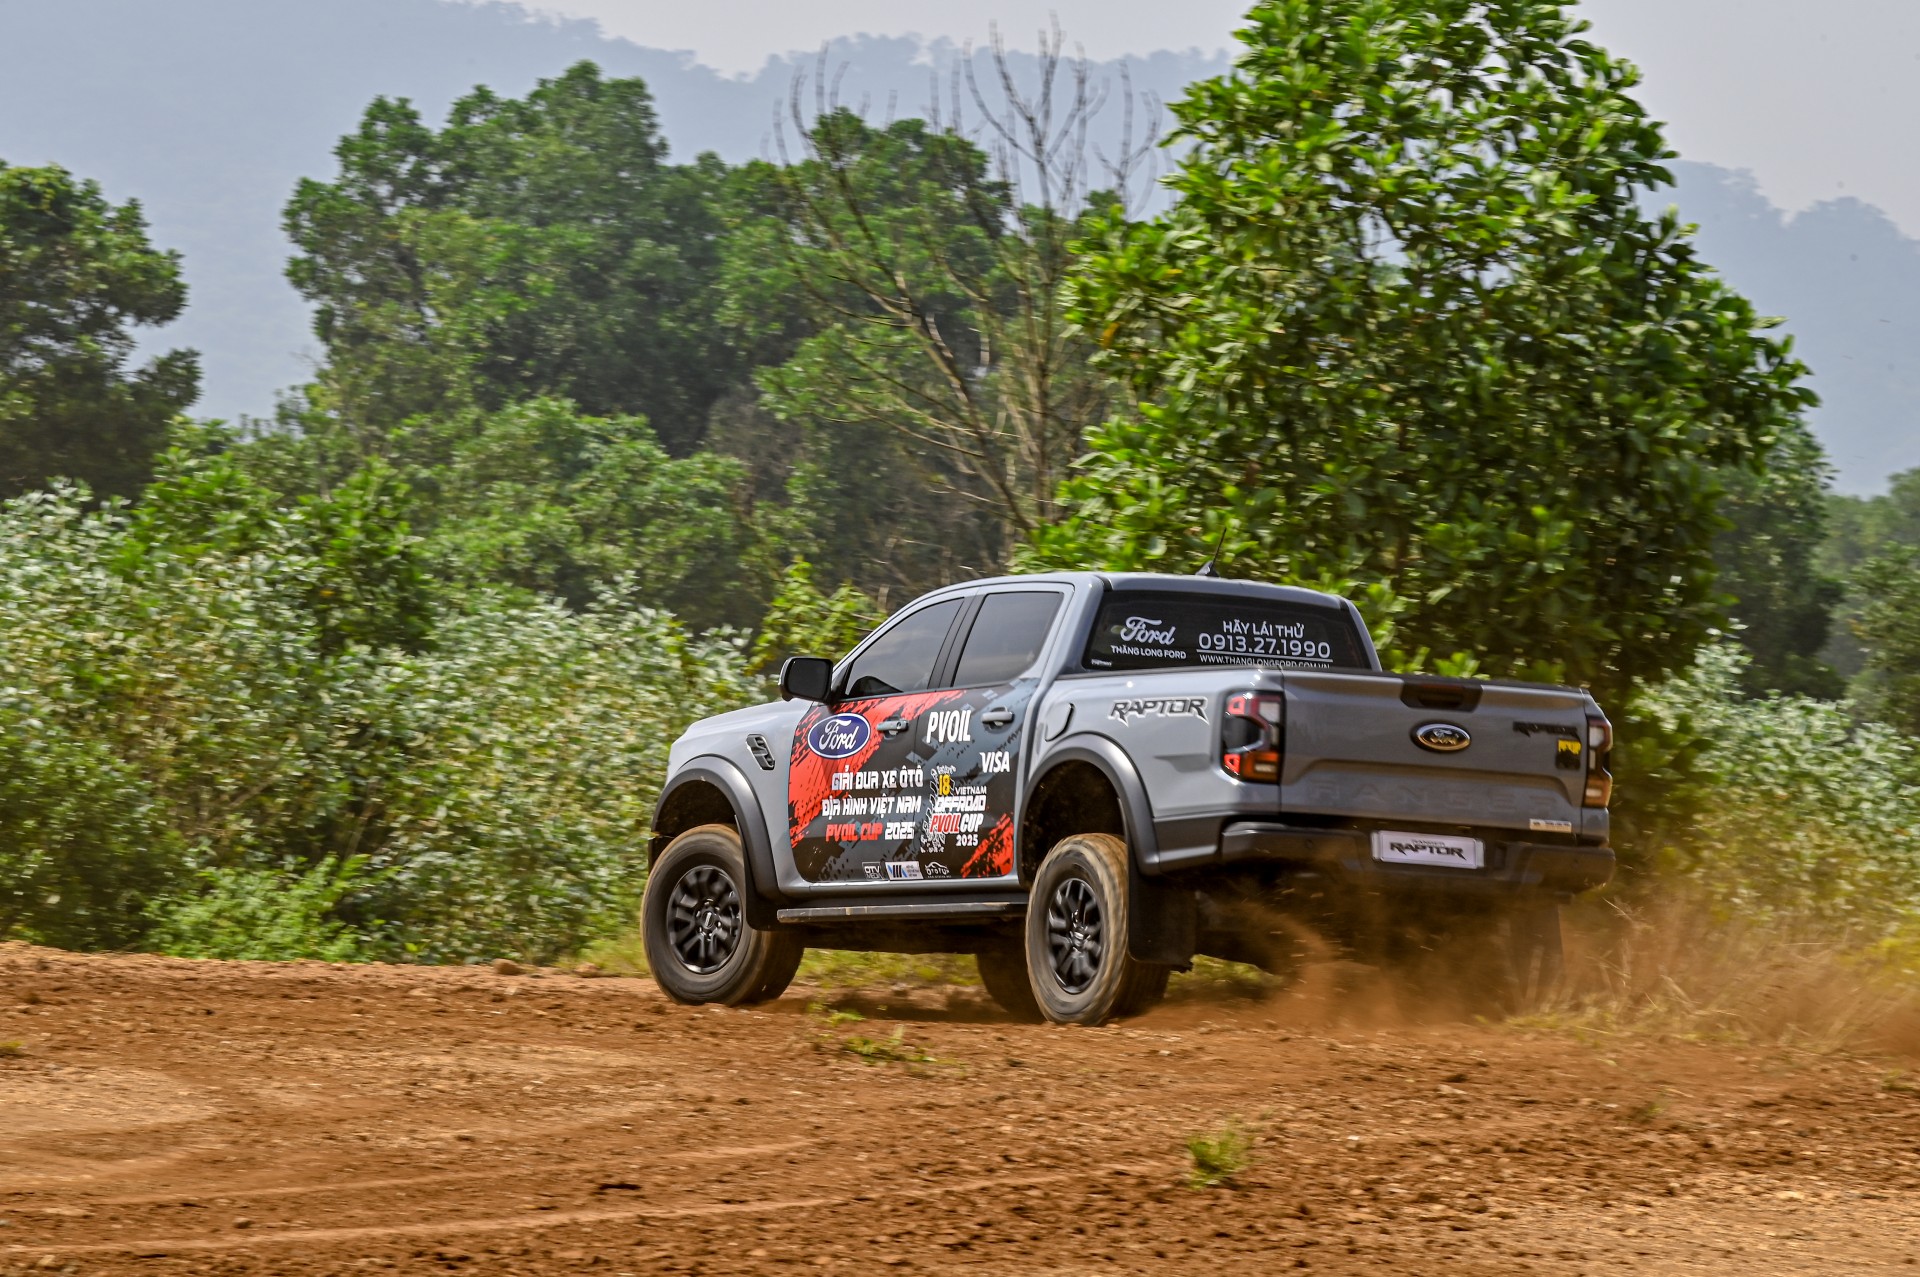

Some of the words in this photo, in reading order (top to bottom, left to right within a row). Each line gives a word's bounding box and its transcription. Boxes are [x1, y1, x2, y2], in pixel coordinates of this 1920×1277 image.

[1120, 616, 1176, 645] Ford
[1223, 619, 1250, 634] HÃY
[1252, 620, 1273, 636] LÁI
[1275, 622, 1304, 639] THỬ
[1110, 644, 1139, 656] THĂNG
[1140, 648, 1163, 658] LONG
[1164, 650, 1187, 660] FORD
[1198, 632, 1331, 659] 0913.27.1990
[1200, 654, 1330, 669] WWW.THANGLONGFORDCOMVN
[1108, 696, 1210, 727] RAPTOR
[818, 719, 860, 750] Ford
[926, 710, 971, 744] PVOIL
[979, 751, 1010, 773] VISA
[831, 764, 854, 790] GIẢI
[880, 770, 897, 788] XE
[899, 764, 923, 788] ÔTÔ
[938, 773, 951, 796] 18
[954, 785, 988, 795] VIETNAM
[842, 794, 868, 815] HÌNH
[869, 792, 896, 818] VIỆT
[896, 795, 922, 814] NAM
[934, 794, 987, 812] OFFROAD
[825, 822, 859, 842] PVOIL
[860, 822, 884, 841] CUP
[884, 821, 916, 840] 2025
[929, 813, 961, 834] PVOIL
[960, 812, 984, 833] CUP
[955, 833, 979, 847] 2025
[1389, 841, 1467, 861] RAPTOR
